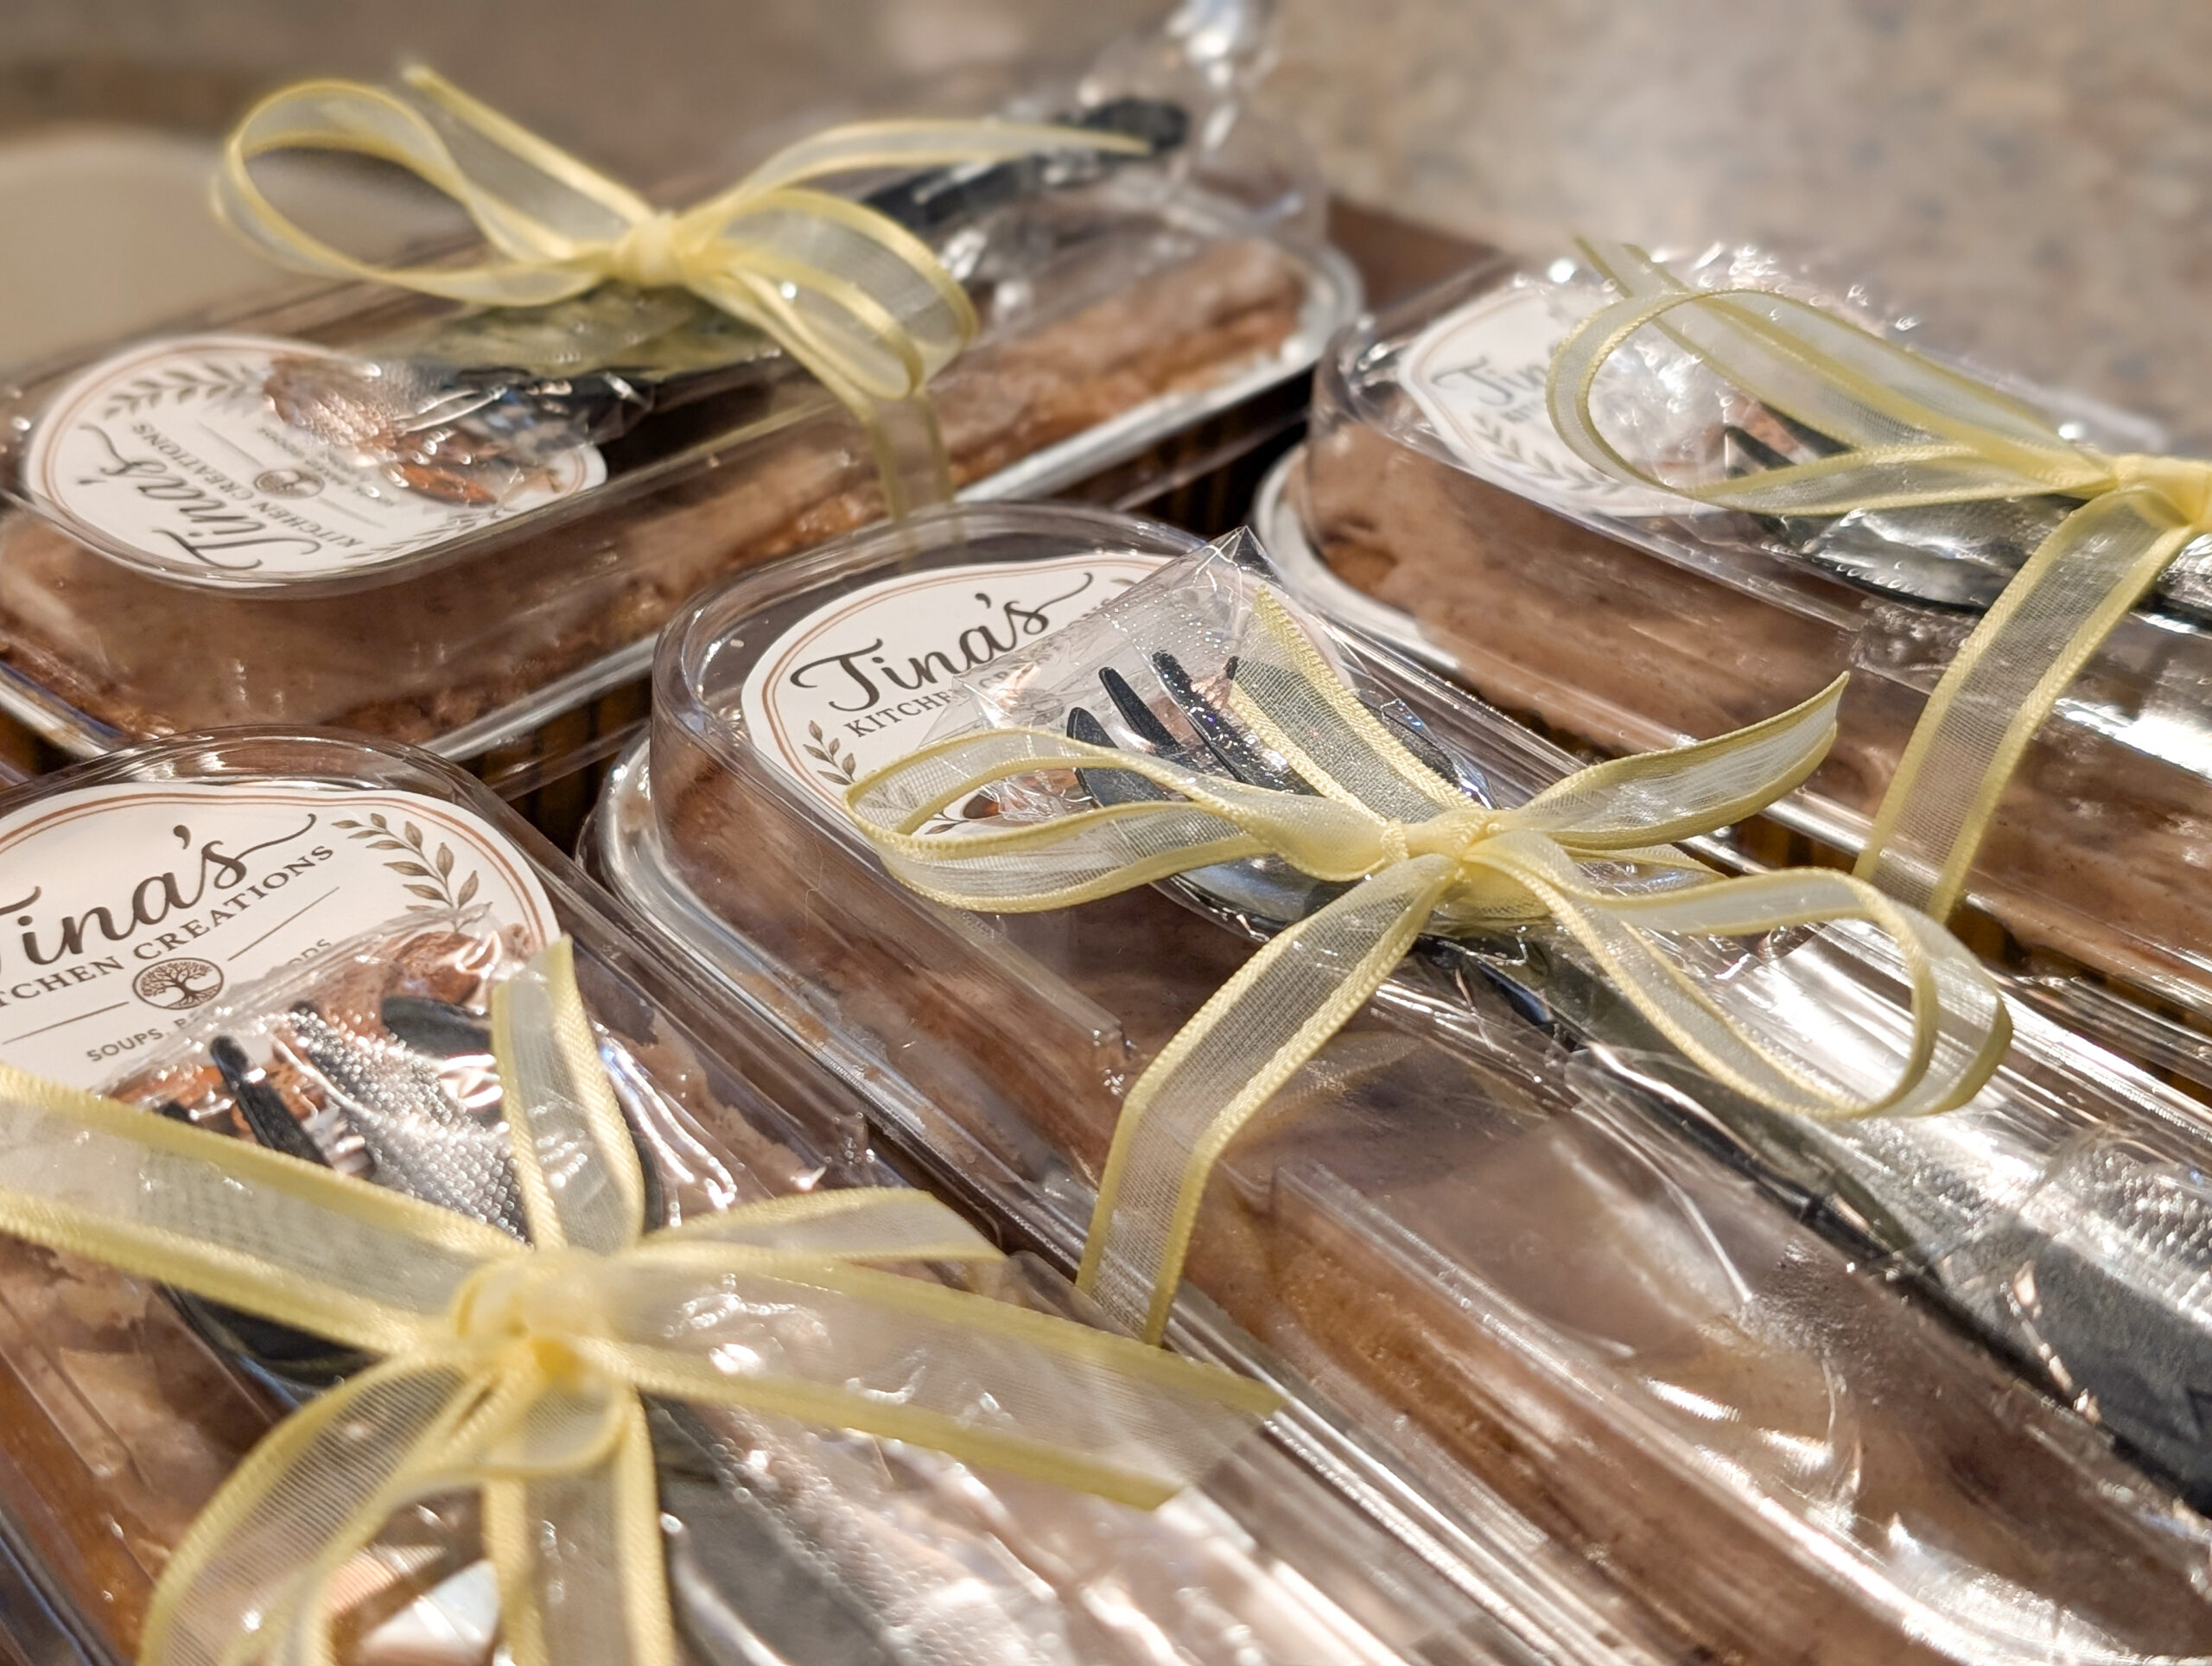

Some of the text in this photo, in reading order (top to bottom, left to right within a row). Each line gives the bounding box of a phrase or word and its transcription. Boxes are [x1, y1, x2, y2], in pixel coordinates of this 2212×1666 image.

[132, 422, 254, 501] CREATIONS
[789, 572, 1094, 712] Tina's
[133, 845, 334, 960] CREATIONS
